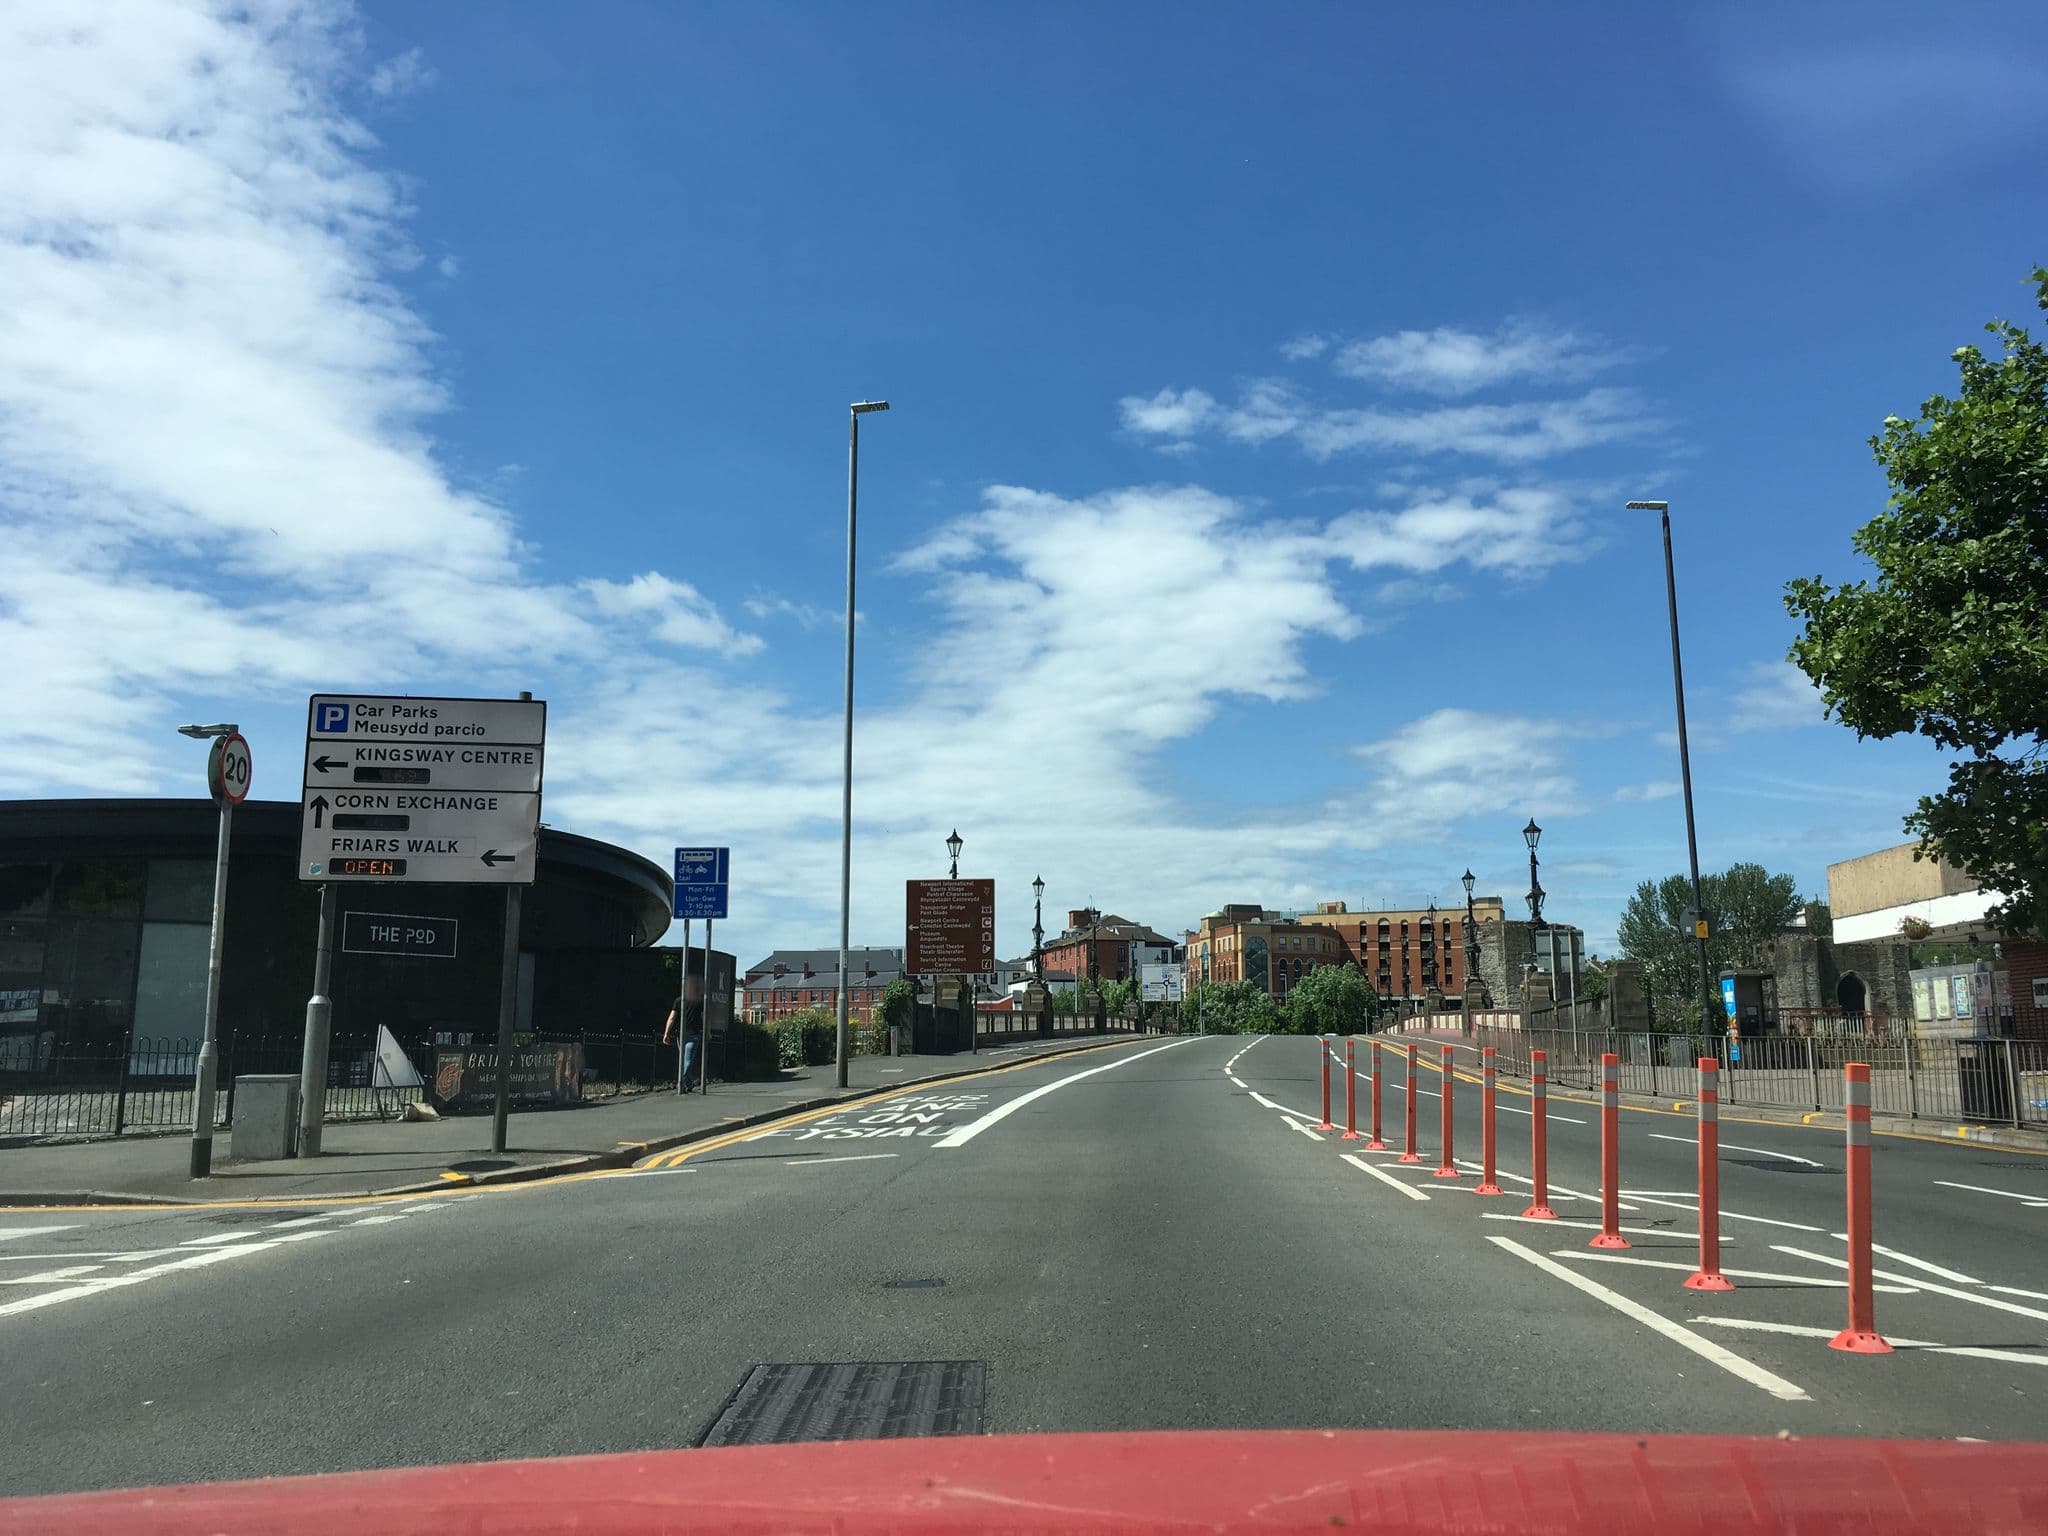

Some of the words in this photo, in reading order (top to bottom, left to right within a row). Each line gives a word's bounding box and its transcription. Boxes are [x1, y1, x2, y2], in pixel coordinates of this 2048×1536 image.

[323, 706, 345, 730] P
[355, 703, 385, 718] Car
[391, 705, 438, 719] Parks
[354, 720, 429, 736] Meusydd
[434, 723, 486, 737] parcio
[355, 748, 456, 764] KINGSWAY
[461, 751, 534, 765] CENTRE
[224, 752, 247, 785] 20
[335, 795, 390, 809] CORN
[396, 796, 499, 811] EXCHANGE
[331, 838, 400, 852] FRIARS
[407, 839, 460, 854] WALK
[344, 861, 394, 875] OPEN
[369, 925, 401, 943] THE
[405, 928, 437, 945] POD
[840, 1101, 989, 1113] LANE
[885, 1094, 989, 1104] BUS
